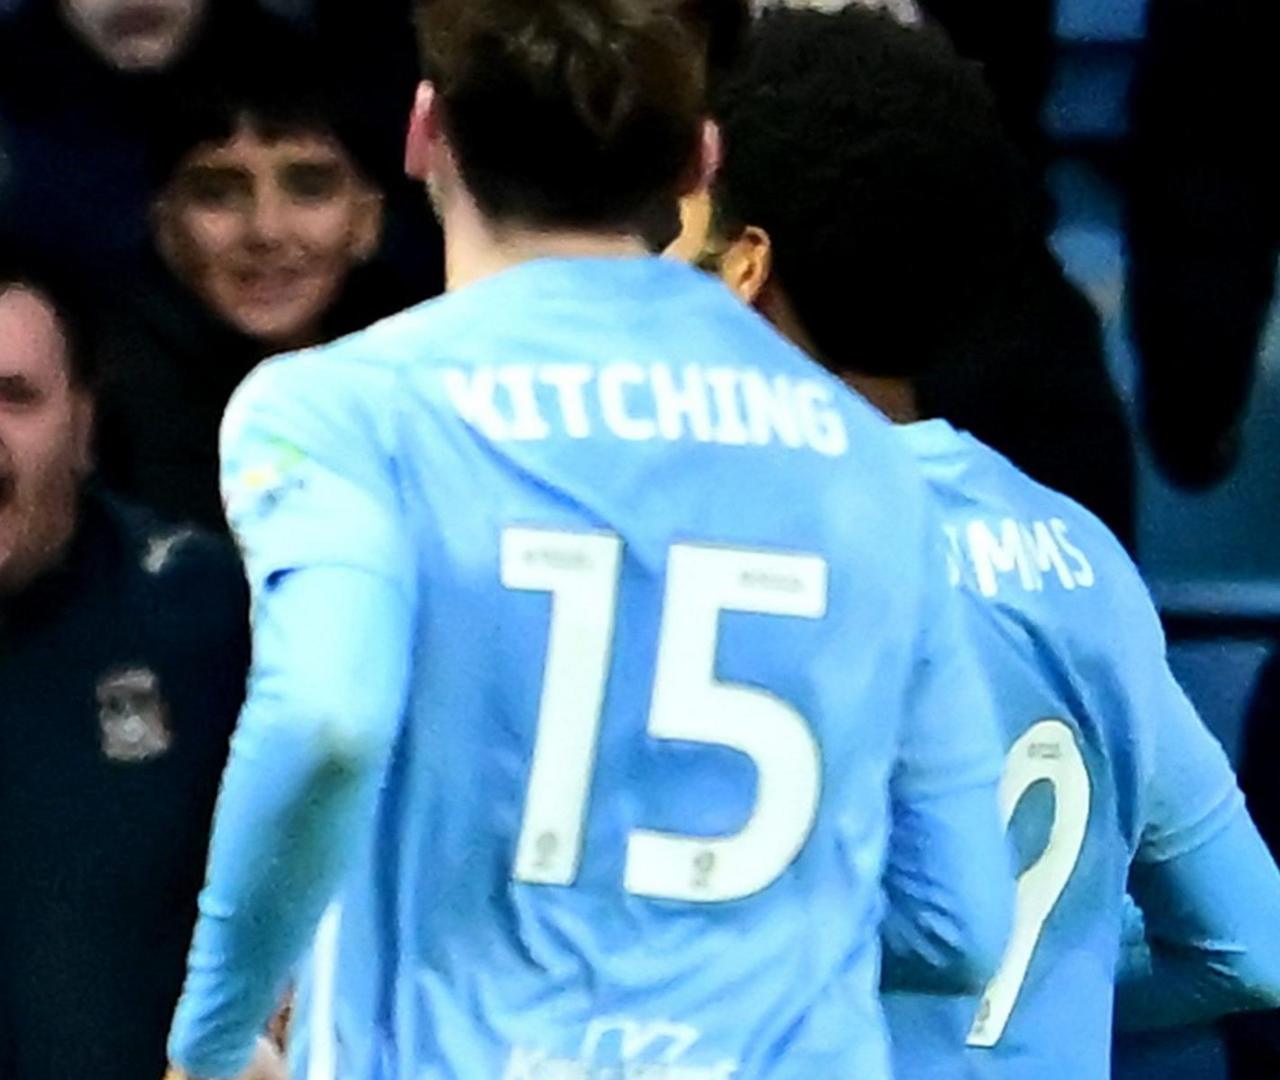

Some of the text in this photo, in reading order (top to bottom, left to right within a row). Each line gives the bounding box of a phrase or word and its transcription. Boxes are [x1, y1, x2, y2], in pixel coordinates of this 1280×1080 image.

[445, 362, 851, 456] KITCHING
[499, 525, 830, 904] 15
[966, 717, 1091, 1049] 9
